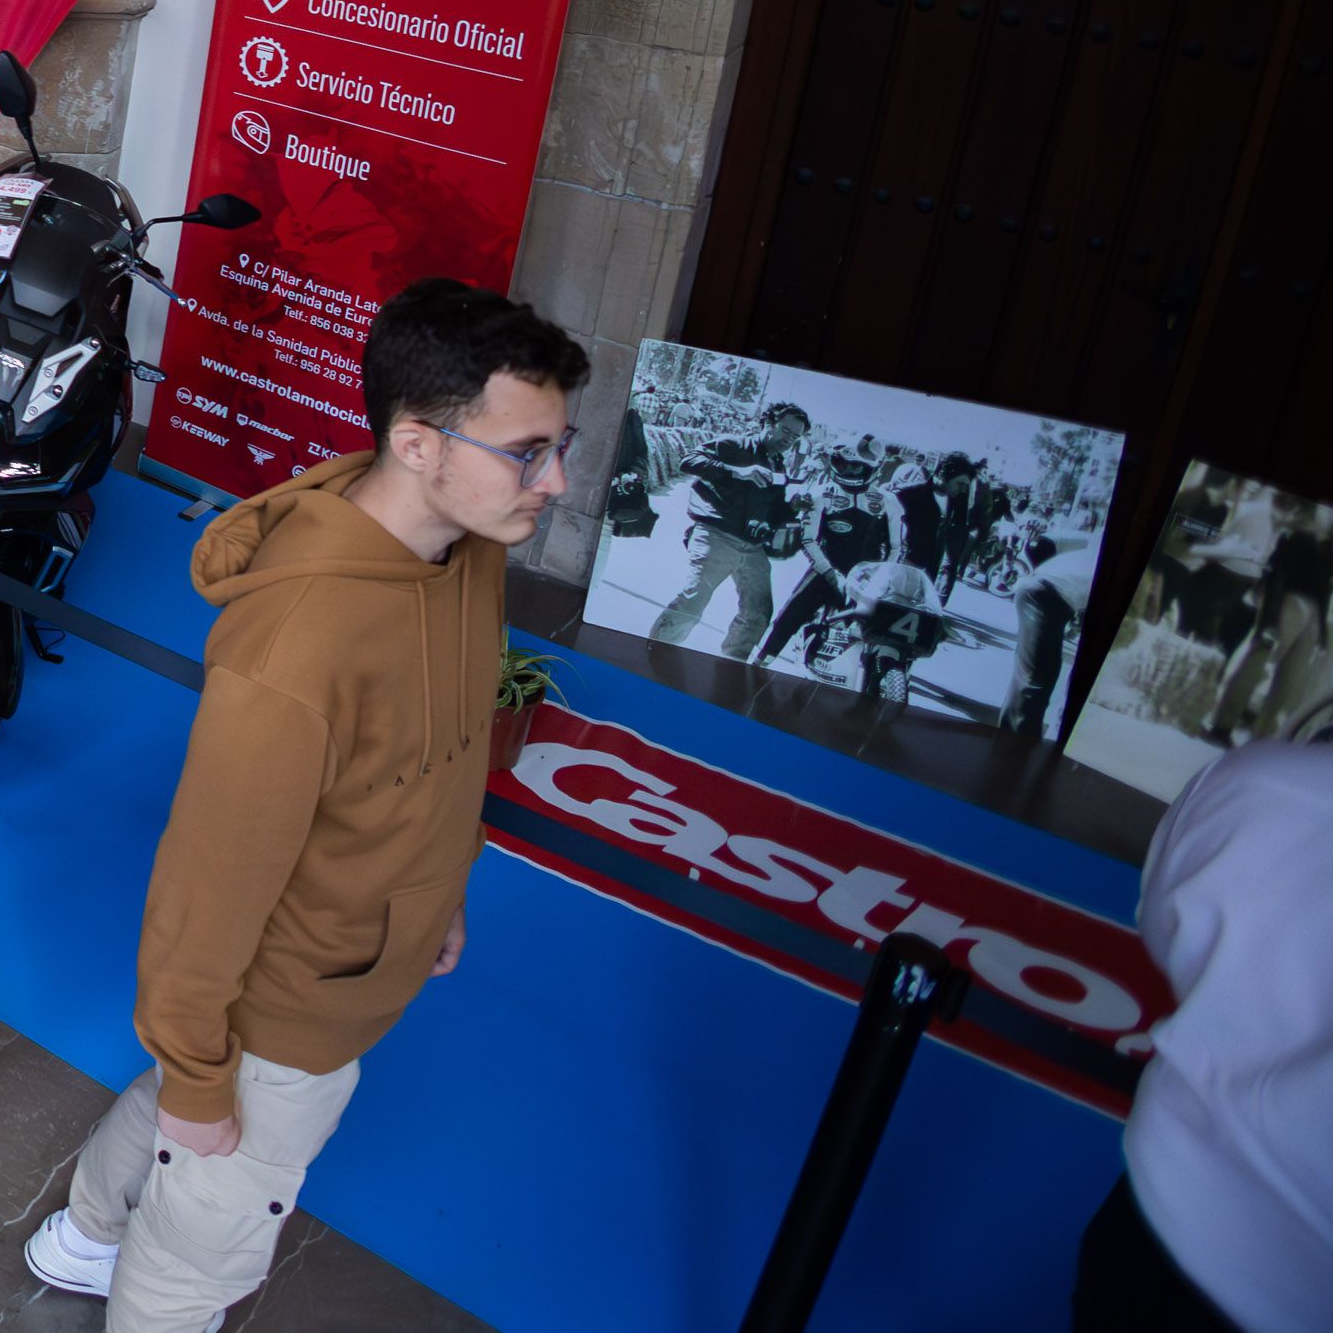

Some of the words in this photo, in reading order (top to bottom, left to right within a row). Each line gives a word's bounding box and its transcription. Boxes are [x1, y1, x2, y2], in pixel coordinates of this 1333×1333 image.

[453, 19, 525, 60] Oficial
[296, 62, 374, 105] Servicio
[379, 80, 456, 126] Técnico
[284, 133, 371, 181] Boutique
[220, 265, 269, 292] Esquina
[271, 283, 322, 311] Avenida
[325, 302, 342, 317] de
[253, 261, 269, 278] C/
[271, 267, 302, 288] Pilar
[304, 279, 352, 305] Aranda
[198, 305, 230, 327] Avda.
[233, 319, 249, 333] de
[251, 324, 264, 339] la
[267, 329, 318, 359] Sanidad
[320, 348, 363, 375] Públic
[283, 305, 308, 324] Telf.:
[310, 315, 331, 331] 856
[332, 322, 354, 339] 038
[274, 348, 299, 367] Telf.:
[300, 359, 321, 375] 956
[322, 368, 337, 381] 28
[338, 373, 353, 387] 92
[182, 420, 230, 447] KEEWAY
[192, 395, 229, 418] SYM
[249, 419, 295, 442] macbor
[889, 612, 921, 643] 4
[511, 740, 1141, 1032] Castro
